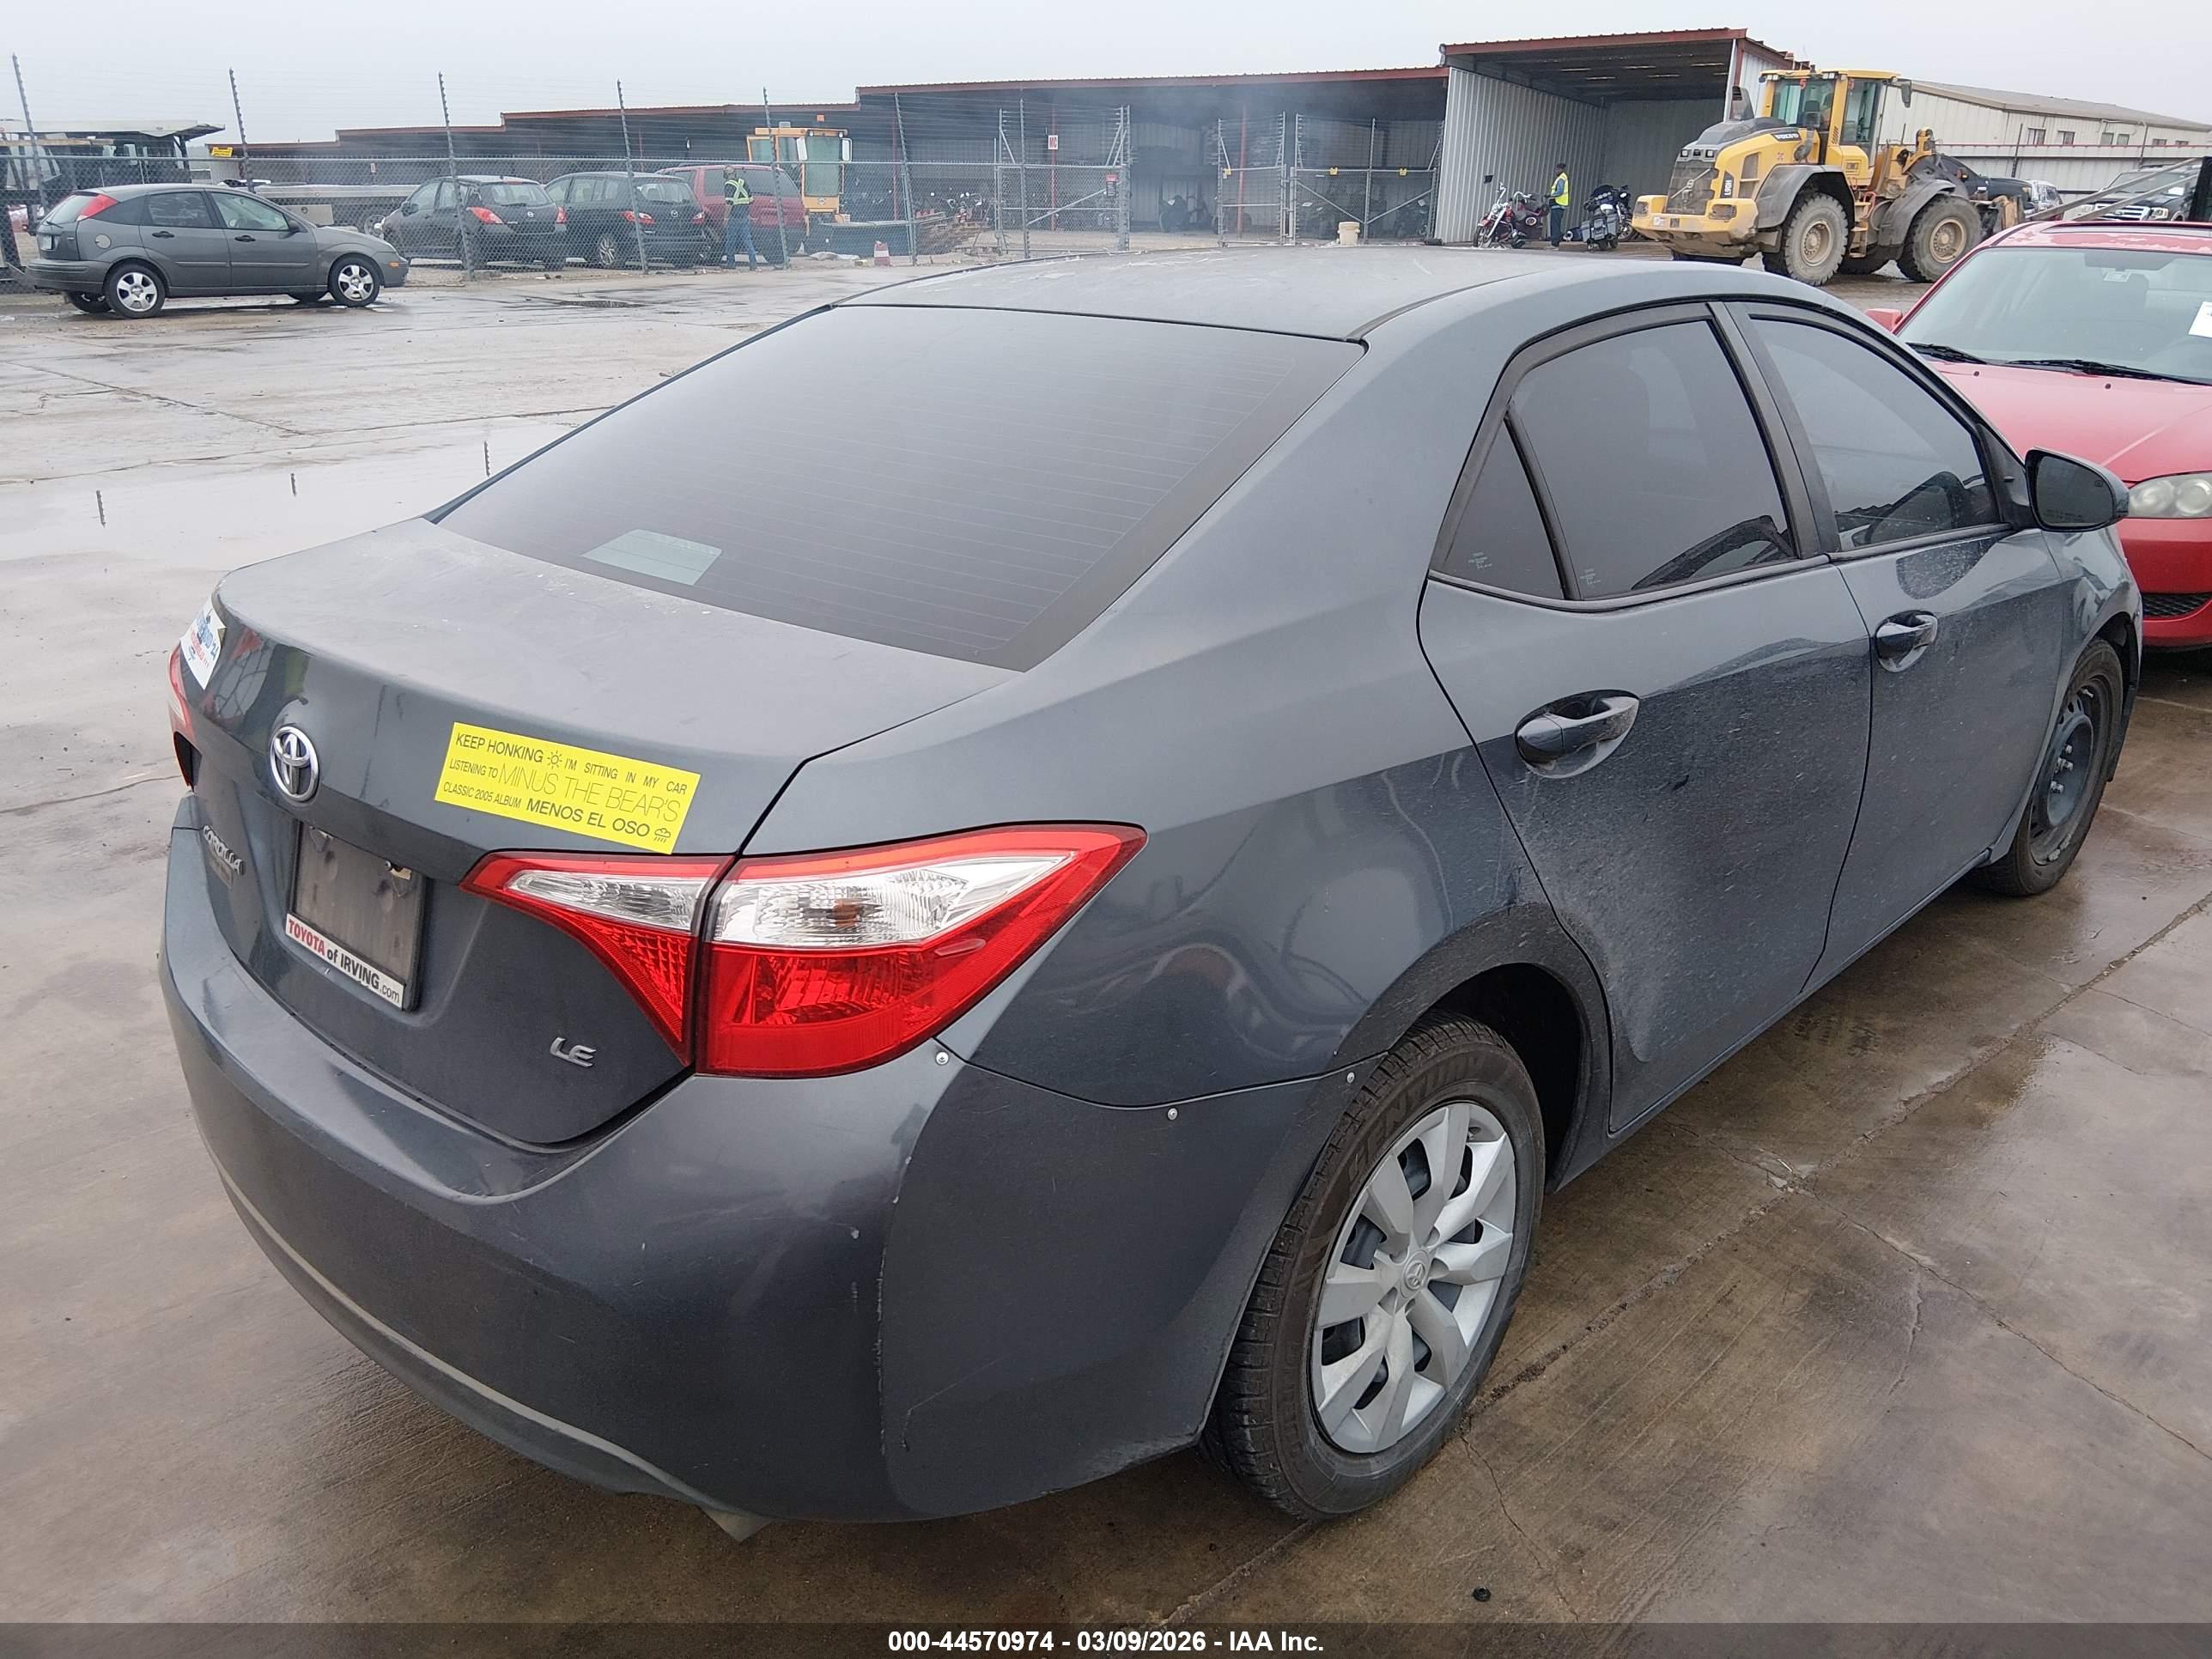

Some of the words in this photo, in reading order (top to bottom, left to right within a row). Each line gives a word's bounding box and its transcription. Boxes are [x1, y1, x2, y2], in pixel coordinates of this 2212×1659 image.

[456, 732, 485, 750] KEEP
[487, 739, 544, 763] HONKING
[565, 758, 577, 770] I'M
[584, 763, 618, 779] SITTING
[625, 772, 636, 783] IN
[643, 776, 659, 788] MY
[666, 781, 687, 794] CAR
[444, 782, 474, 797] CLASSIC
[475, 789, 494, 802] 2005
[494, 793, 522, 808] ALBUM
[526, 799, 584, 822] MENOS
[586, 812, 606, 828] EL
[612, 818, 650, 836] OSO
[450, 758, 486, 775] LISTENING
[489, 767, 498, 778] TO
[499, 763, 558, 794] MINUS
[565, 776, 605, 805] THE
[605, 787, 681, 822] BEAR'S
[203, 825, 244, 876] COROLLA
[289, 920, 325, 956] TOYOTA
[327, 949, 338, 963] of
[550, 1036, 597, 1067] LE
